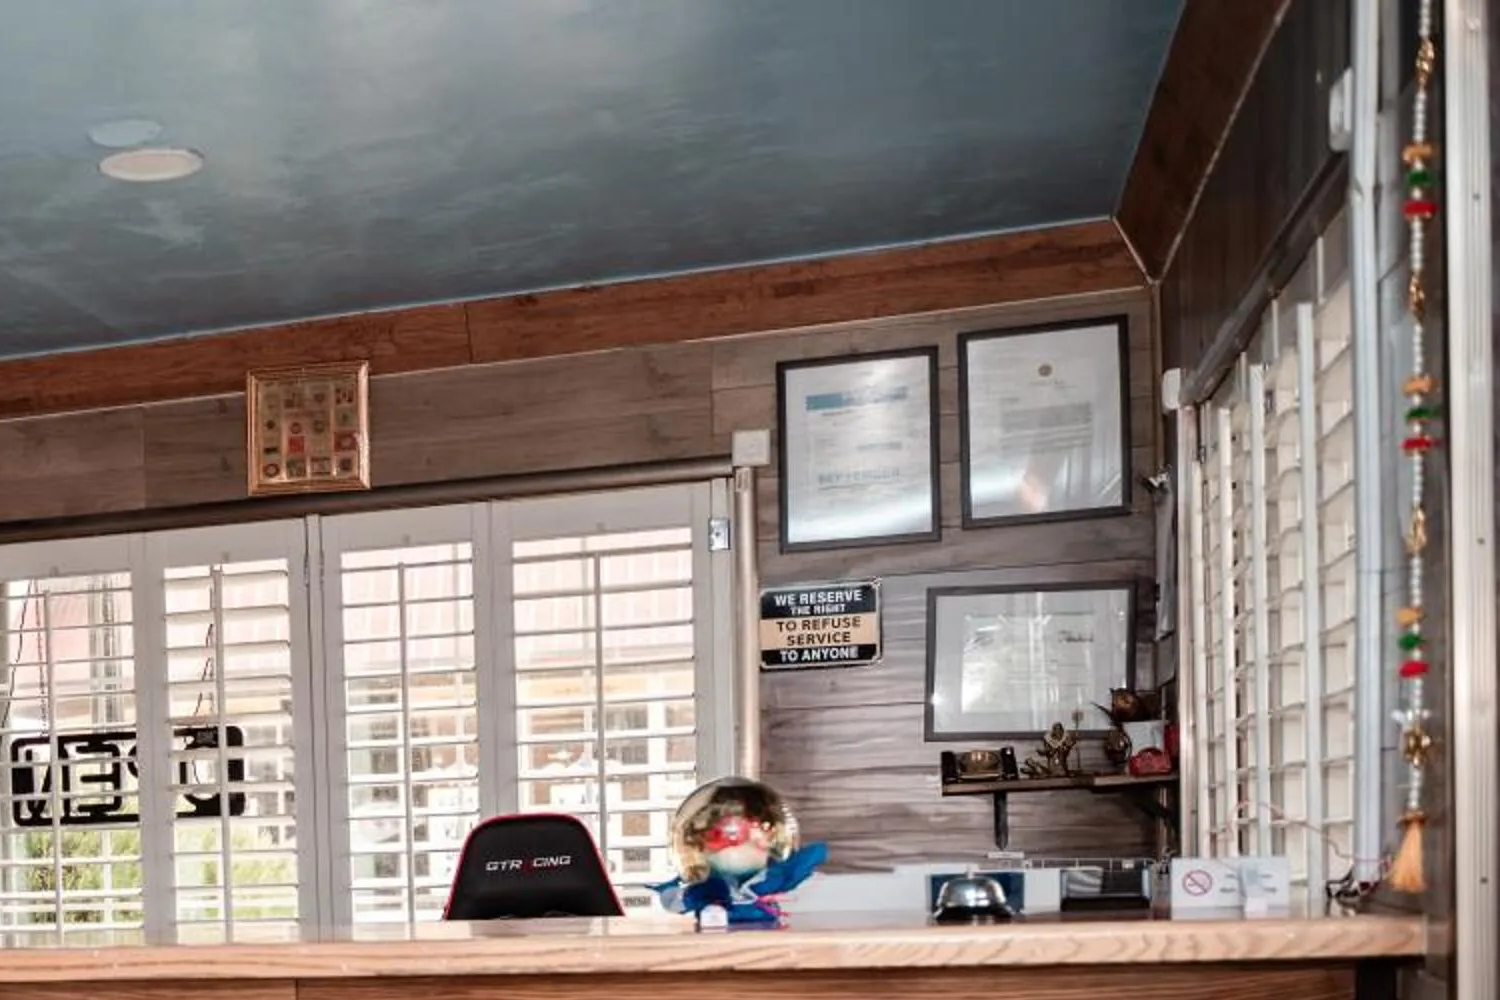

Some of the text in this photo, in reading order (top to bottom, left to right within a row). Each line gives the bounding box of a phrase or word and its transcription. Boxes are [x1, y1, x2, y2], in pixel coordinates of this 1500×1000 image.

[773, 589, 863, 607] WE RESERVE
[790, 603, 846, 616] THE RIGHT
[776, 616, 861, 632] TO REFUSE
[787, 631, 852, 647] SERVICE
[779, 646, 859, 662] TO ANYONE
[485, 855, 572, 871] GTRCING
